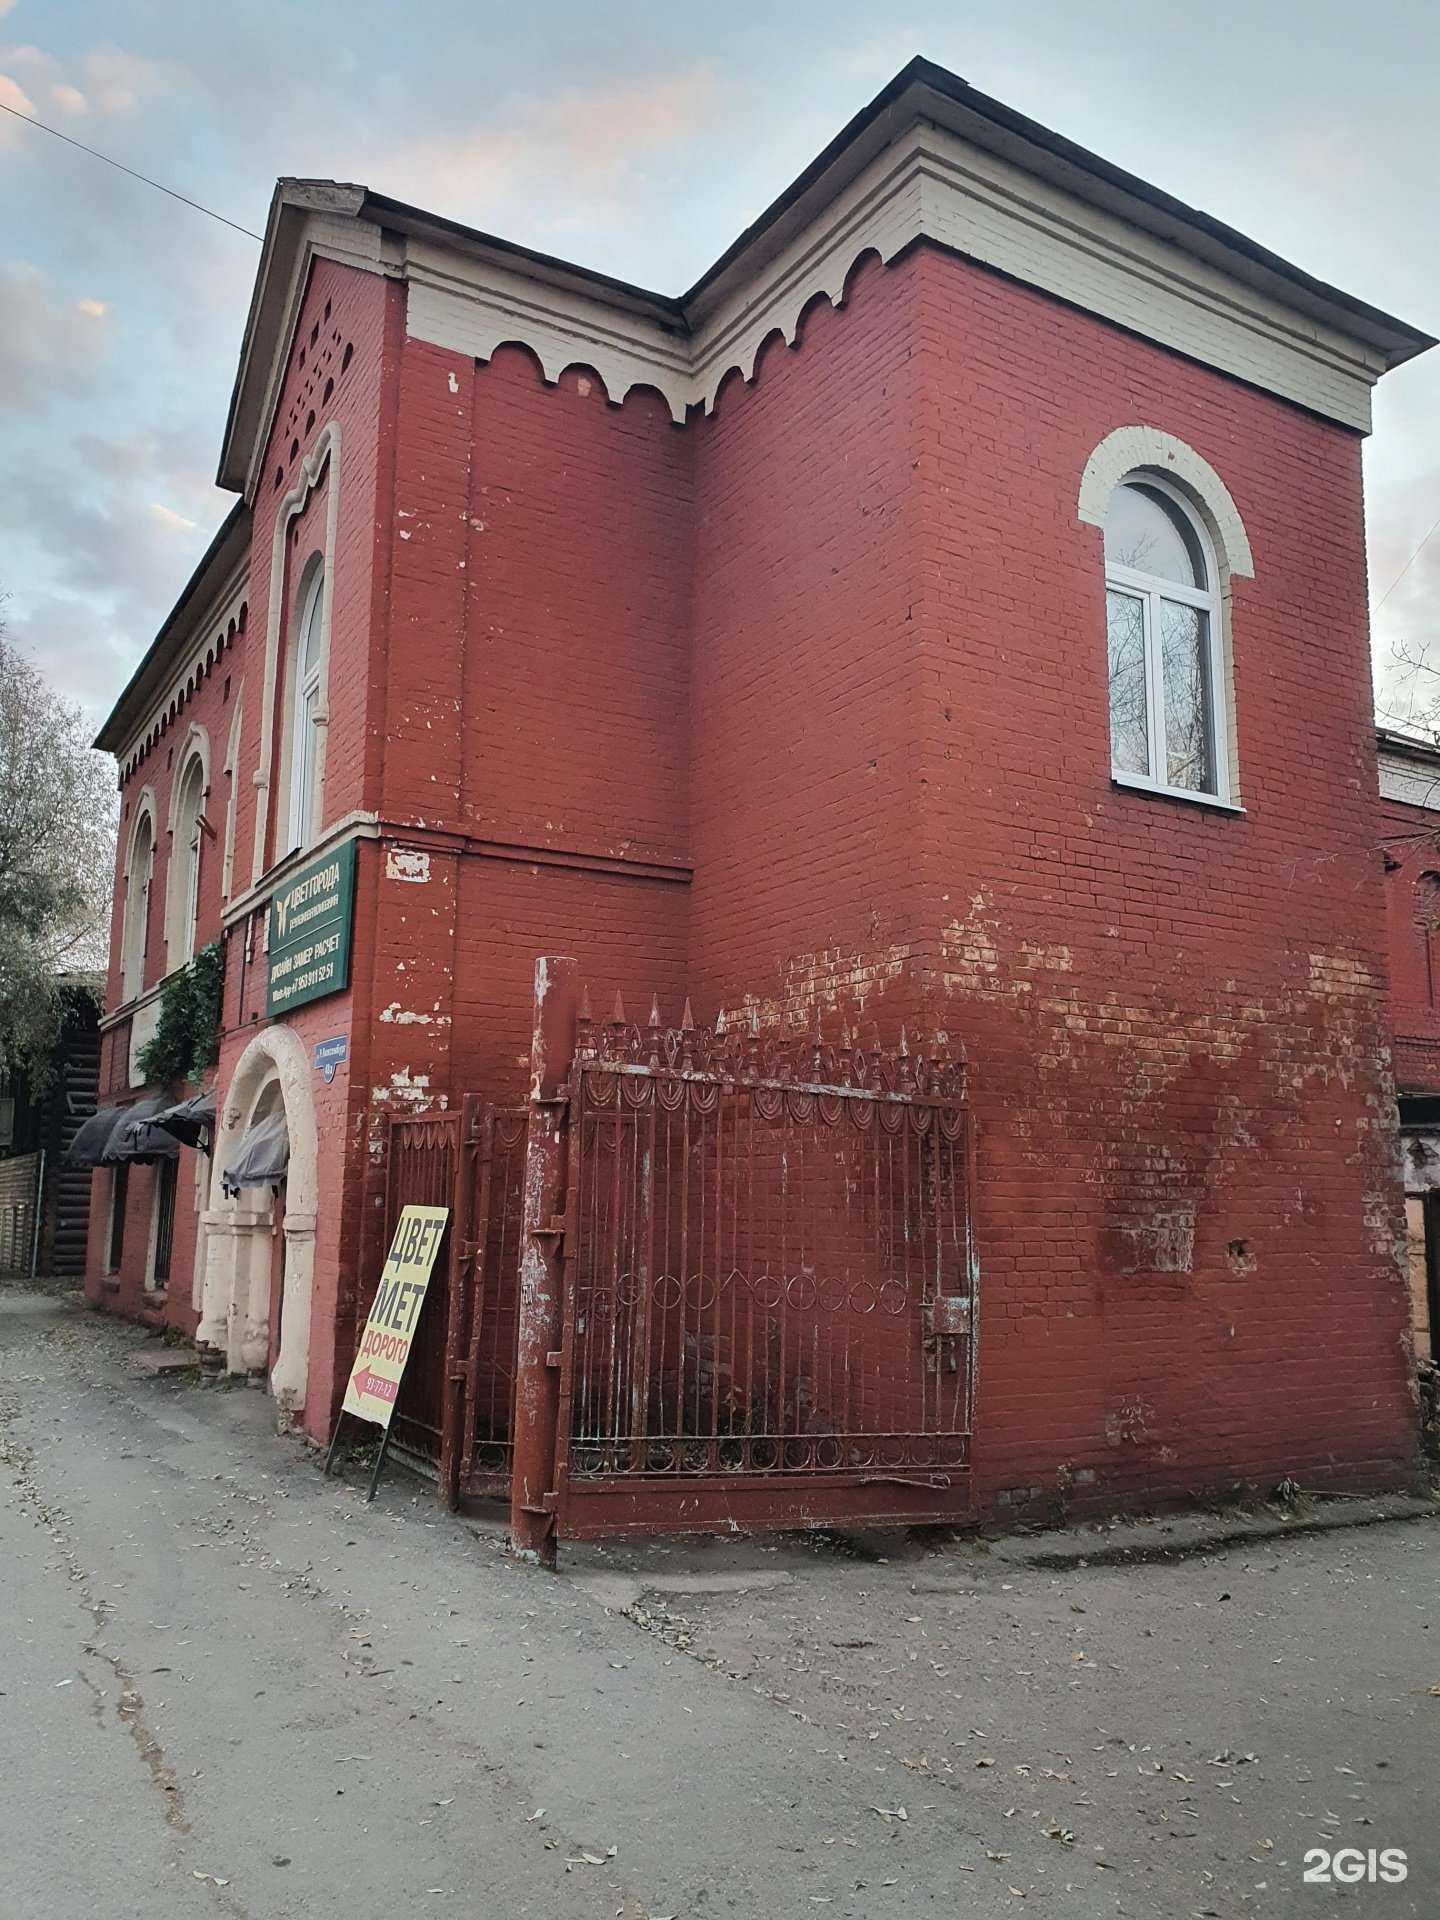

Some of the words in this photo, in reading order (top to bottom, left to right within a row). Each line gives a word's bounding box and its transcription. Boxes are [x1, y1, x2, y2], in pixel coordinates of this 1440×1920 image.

[291, 880, 310, 911] ЦВЕТ
[309, 862, 339, 892] ГОРОДА
[271, 956, 293, 984] ДИЗАЙН
[293, 947, 313, 970] ЗАМЕР
[314, 933, 341, 960] РАСЧЕТ
[389, 1217, 445, 1273] ЦВЕТ
[370, 1279, 425, 1332] МЕТ
[360, 1329, 409, 1365] ДОРОГО
